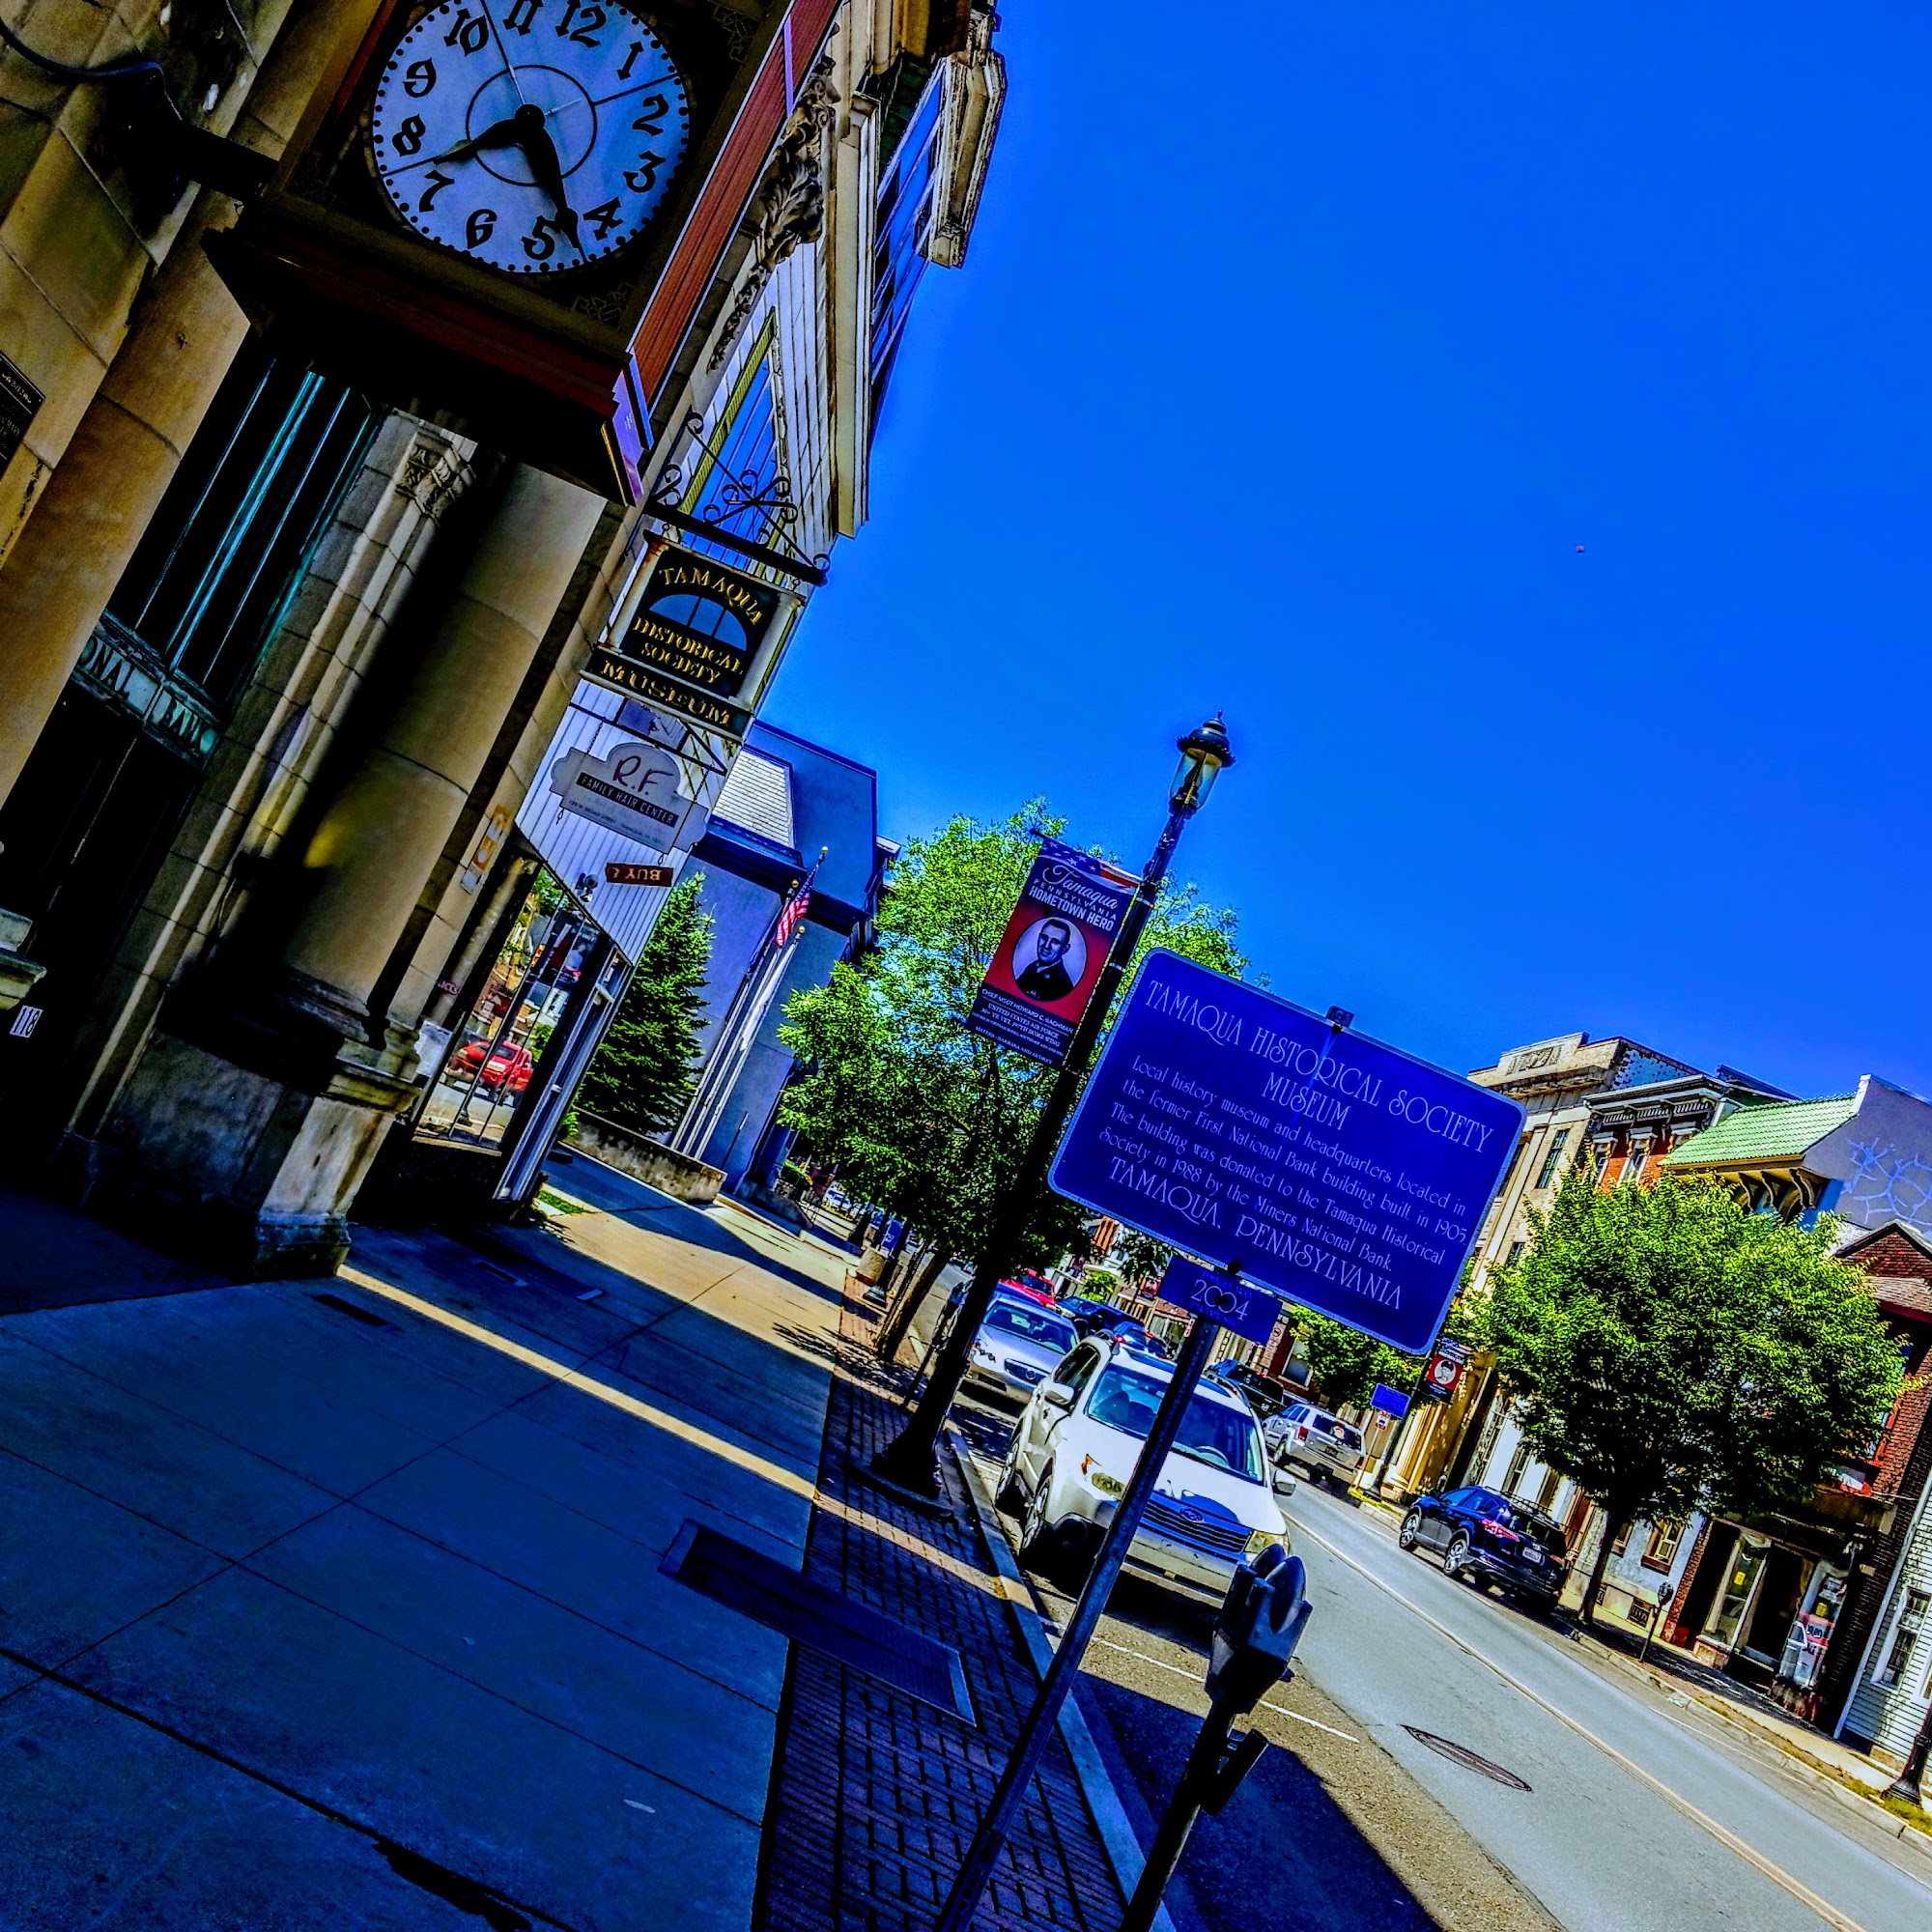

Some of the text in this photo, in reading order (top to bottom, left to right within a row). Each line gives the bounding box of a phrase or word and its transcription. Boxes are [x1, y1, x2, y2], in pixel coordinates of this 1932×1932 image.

[443, 9, 489, 56] 10
[502, 0, 544, 36] 11
[555, 0, 606, 47] 12
[403, 58, 437, 98] 9
[616, 42, 643, 80] 1
[391, 114, 426, 157] 8
[632, 94, 668, 136] 2
[418, 169, 455, 213] 7
[622, 151, 667, 193] 3
[466, 209, 497, 249] 6
[521, 215, 558, 260] 5
[582, 196, 623, 241] 4
[659, 567, 762, 625] TAMAQUA
[633, 617, 743, 674] HISTORICAL
[640, 642, 721, 683] SOCIETY
[600, 660, 729, 724] MUSEUM
[582, 776, 673, 824] FAMILY HAIR CENTER
[624, 867, 662, 880] BUY
[1042, 865, 1118, 909] Tamaqua
[1028, 885, 1114, 931] HOMETOWN HERO
[1034, 878, 1117, 921] PENNSYLVANIA
[14, 1008, 40, 1036] 118
[987, 1003, 1059, 1039] UNITED STATES AIR FORCE
[1012, 1003, 1039, 1018] HOWARD
[1145, 980, 1493, 1152] TAMAQUA HISTORICAL SOCIETY
[1262, 1071, 1351, 1130] MUSEUM
[1132, 1055, 1465, 1216] Local history museum and headquarters located in
[1111, 1101, 1446, 1265] The building was donated to the Tamaqua Historical
[1122, 1079, 1468, 1245] the former First National Bank building built in 1905.
[1099, 1126, 1392, 1271] Society in 1988 by the Miners National Bank.
[1235, 1214, 1401, 1310] PENNSYLVANIA
[1190, 1279, 1249, 1321] 2004
